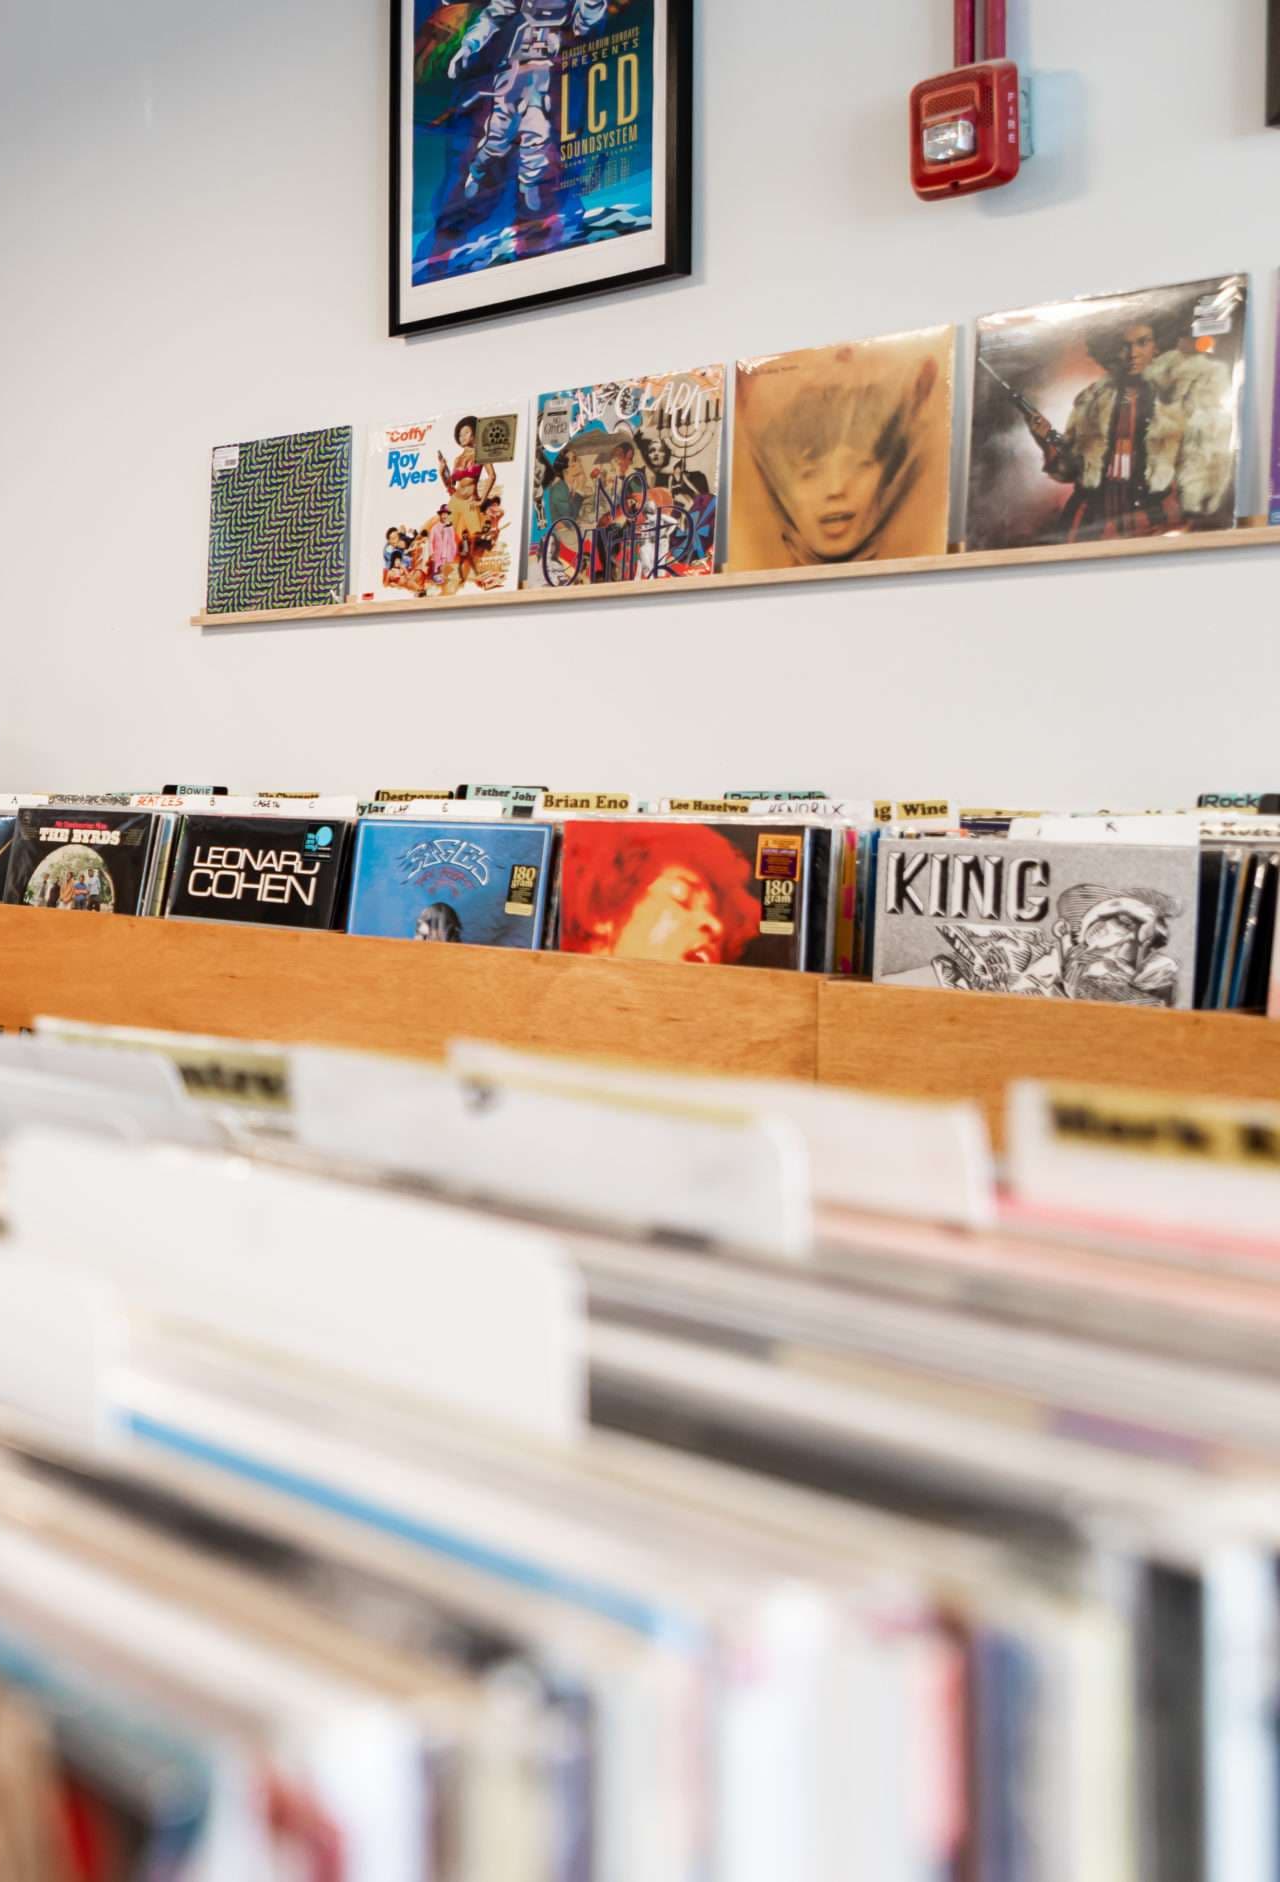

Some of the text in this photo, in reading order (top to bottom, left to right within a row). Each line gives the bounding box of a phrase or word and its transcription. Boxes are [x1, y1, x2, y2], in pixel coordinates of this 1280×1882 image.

[561, 38, 640, 72] PRESENTS
[561, 53, 639, 142] LCD
[560, 124, 638, 161] SOUNDSYSTEM
[386, 424, 432, 442] "Coffy"
[388, 450, 420, 470] Roy
[389, 462, 438, 489] Ayers
[596, 471, 647, 525] NO
[474, 787, 510, 798] Father
[1203, 793, 1258, 808] Rock
[543, 795, 629, 809] Brian Eno
[670, 800, 689, 810] Lee
[902, 803, 948, 817] Wine
[39, 827, 121, 846] THE BYRDS
[512, 866, 536, 880] 180
[188, 868, 317, 906] COHEN
[765, 880, 794, 896] 180
[886, 852, 1050, 922] KING
[764, 895, 792, 906] gram
